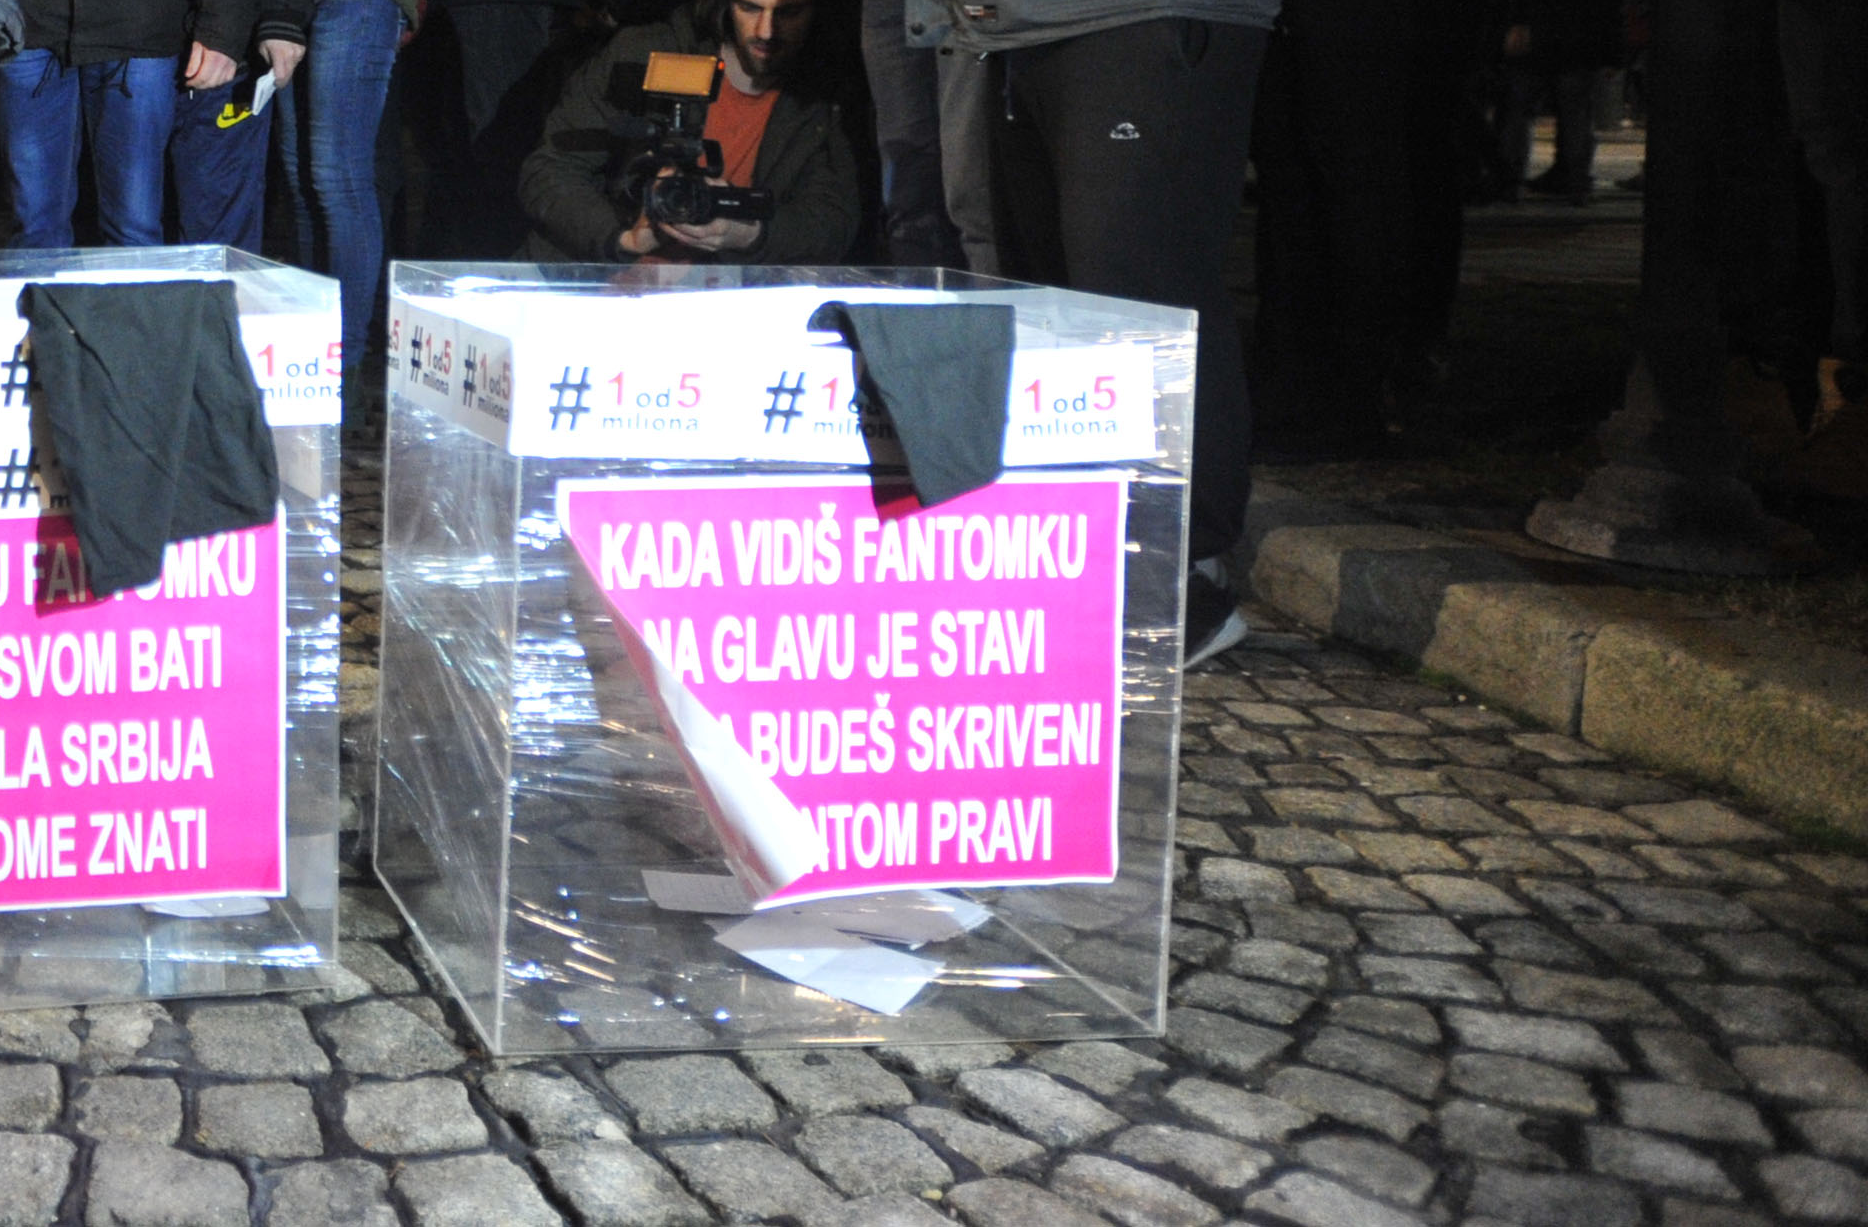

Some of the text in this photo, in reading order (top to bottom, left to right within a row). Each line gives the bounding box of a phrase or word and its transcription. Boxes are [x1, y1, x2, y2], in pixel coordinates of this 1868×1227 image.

[602, 414, 699, 431] miliona
[1022, 419, 1118, 438] miliona
[600, 502, 1087, 590] KADA VIDIŠ FANTOMKU
[132, 626, 222, 691] BATI
[712, 613, 855, 683] GLAVU
[866, 612, 918, 678] JE
[931, 608, 1045, 677] STAVI
[61, 717, 214, 785] SRBIJA
[750, 693, 896, 778] BUDEŠ
[907, 702, 1101, 772] SKRIVENI
[90, 808, 207, 875] ZNATI
[800, 797, 1052, 872] NTOM PRAVI
